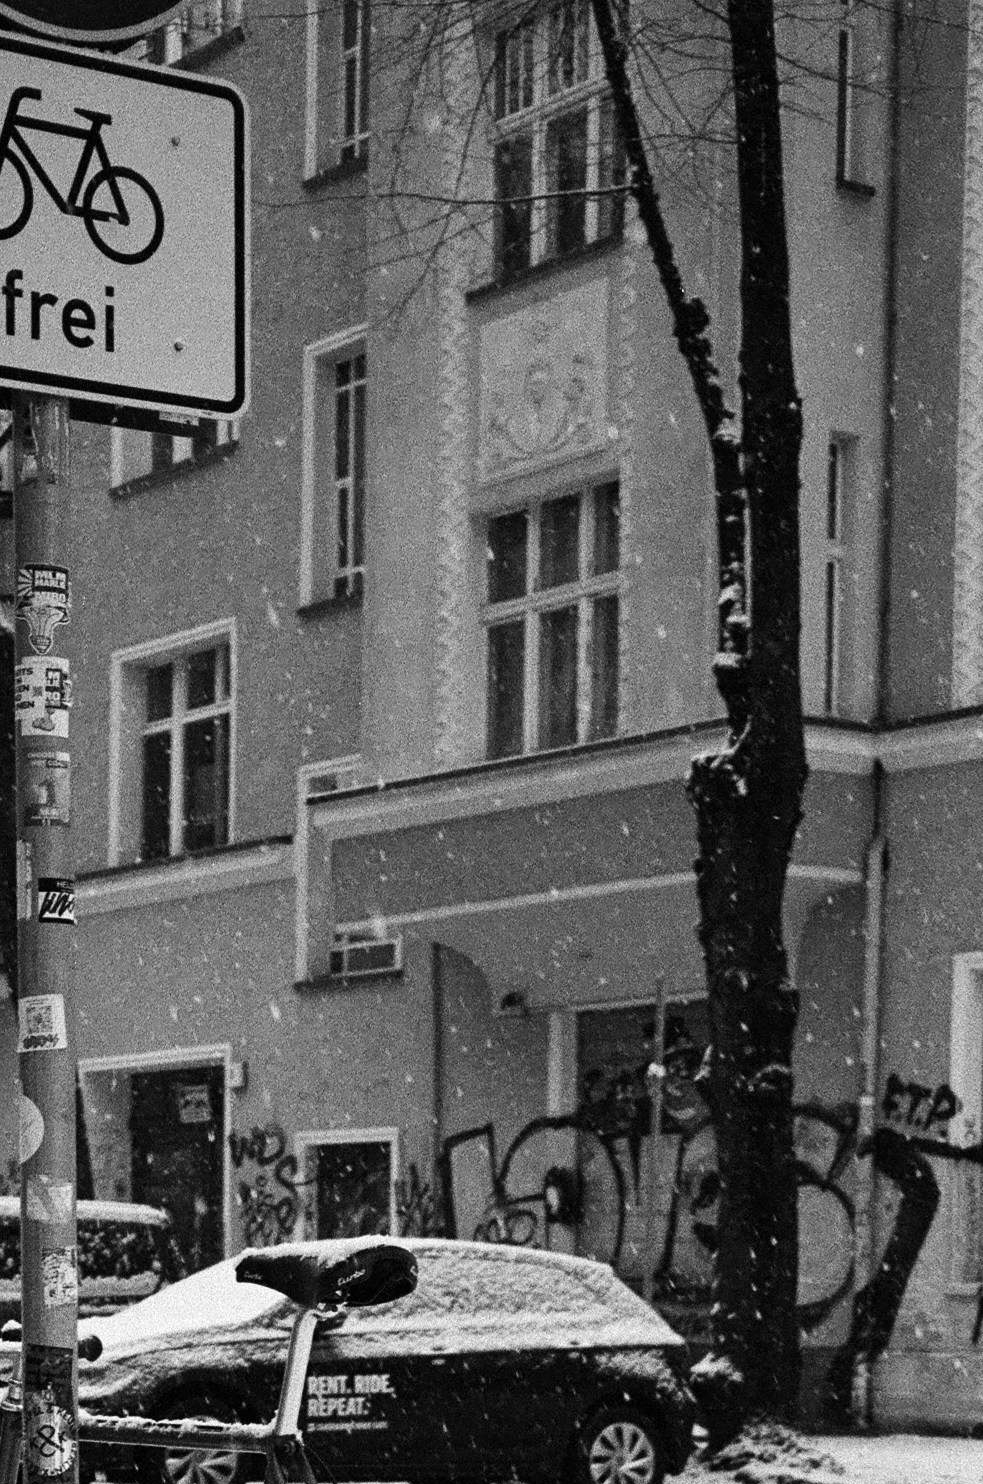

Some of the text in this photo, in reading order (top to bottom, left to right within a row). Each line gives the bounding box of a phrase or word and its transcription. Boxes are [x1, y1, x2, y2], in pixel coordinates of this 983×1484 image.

[1, 269, 115, 352] frei
[307, 1374, 395, 1395] RENT. RIDE.
[307, 1397, 369, 1417] REPEAT.
